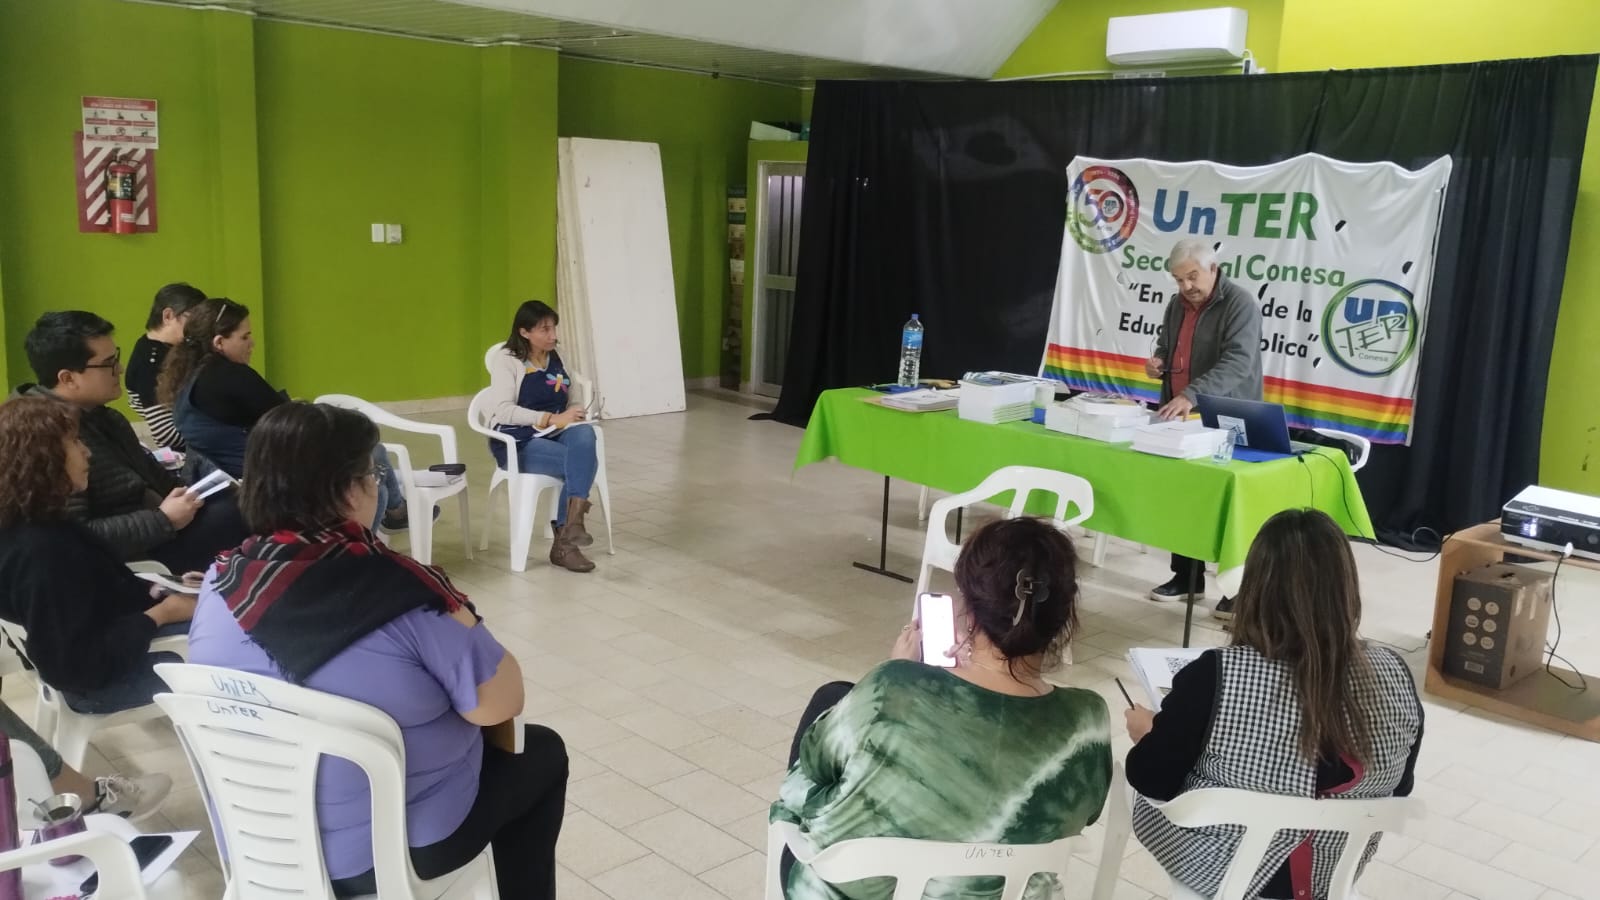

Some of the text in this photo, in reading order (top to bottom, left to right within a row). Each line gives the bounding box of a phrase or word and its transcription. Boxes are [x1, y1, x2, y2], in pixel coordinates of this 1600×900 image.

[1153, 188, 1318, 240] UnTER
[1121, 245, 1346, 288] Secal Conesa
[1261, 297, 1289, 319] de
[1299, 298, 1313, 323] la
[1260, 332, 1319, 358] blica”
